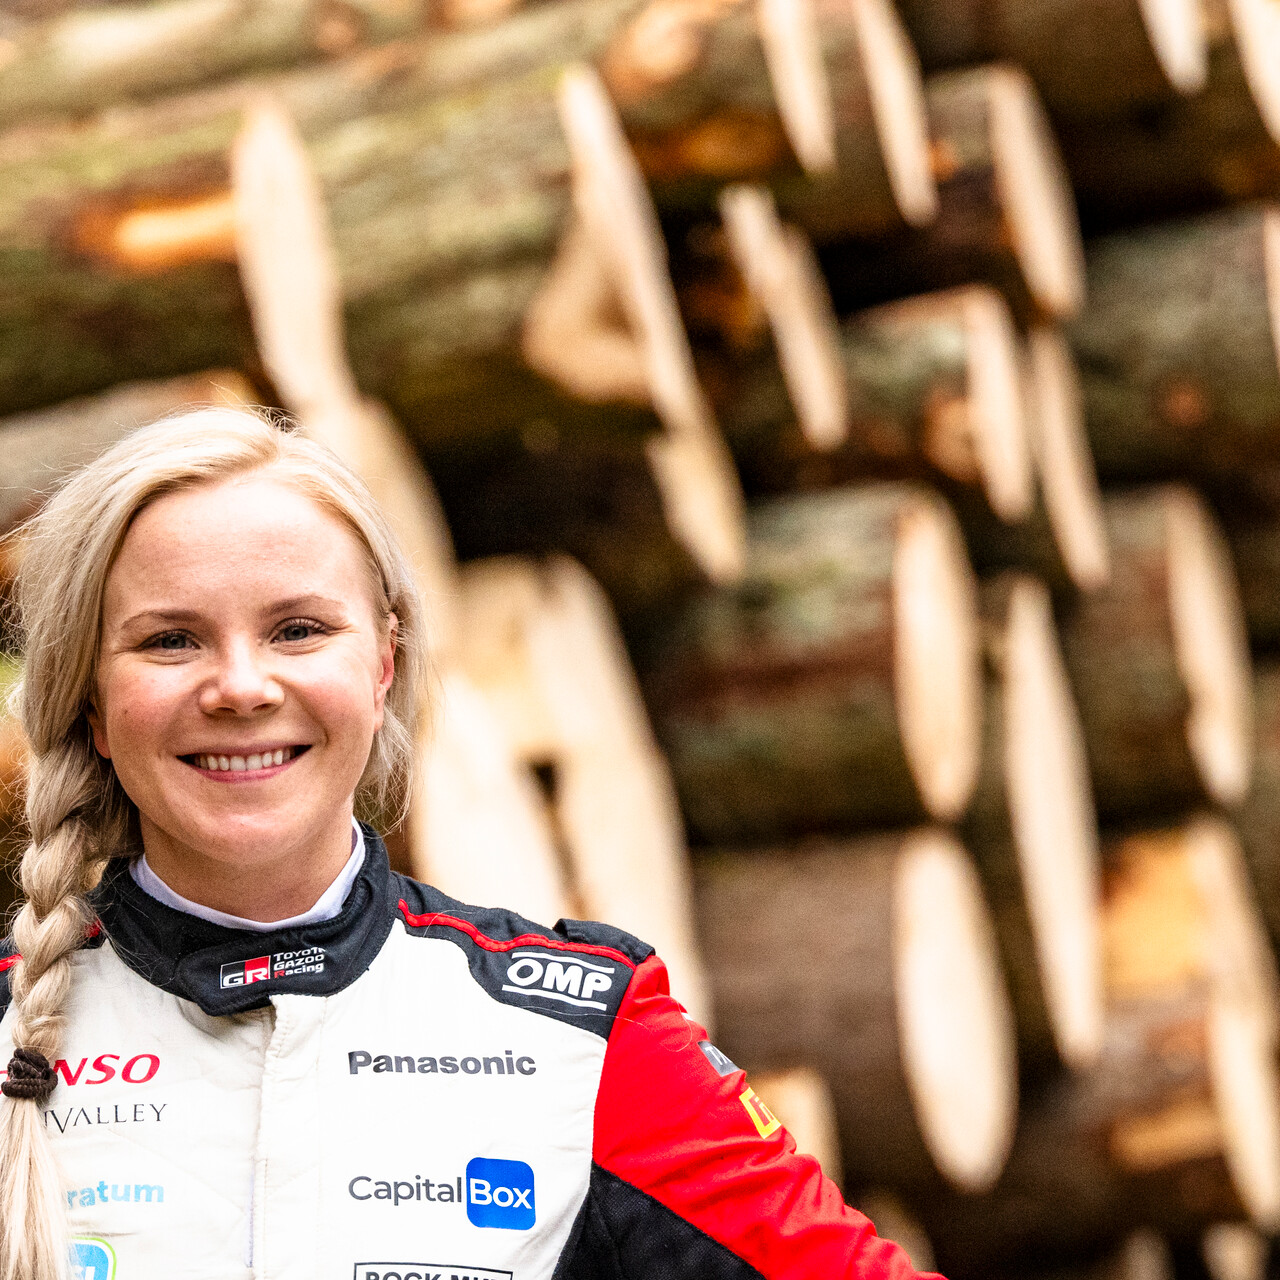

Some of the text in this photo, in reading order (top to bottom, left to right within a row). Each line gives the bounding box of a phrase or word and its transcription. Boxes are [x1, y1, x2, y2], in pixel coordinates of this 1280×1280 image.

[273, 954, 325, 971] GAZOO
[274, 962, 324, 979] Racing
[223, 968, 268, 987] GR
[507, 958, 612, 998] OMP
[348, 1050, 537, 1076] Panasonic
[67, 1181, 164, 1209] ratum
